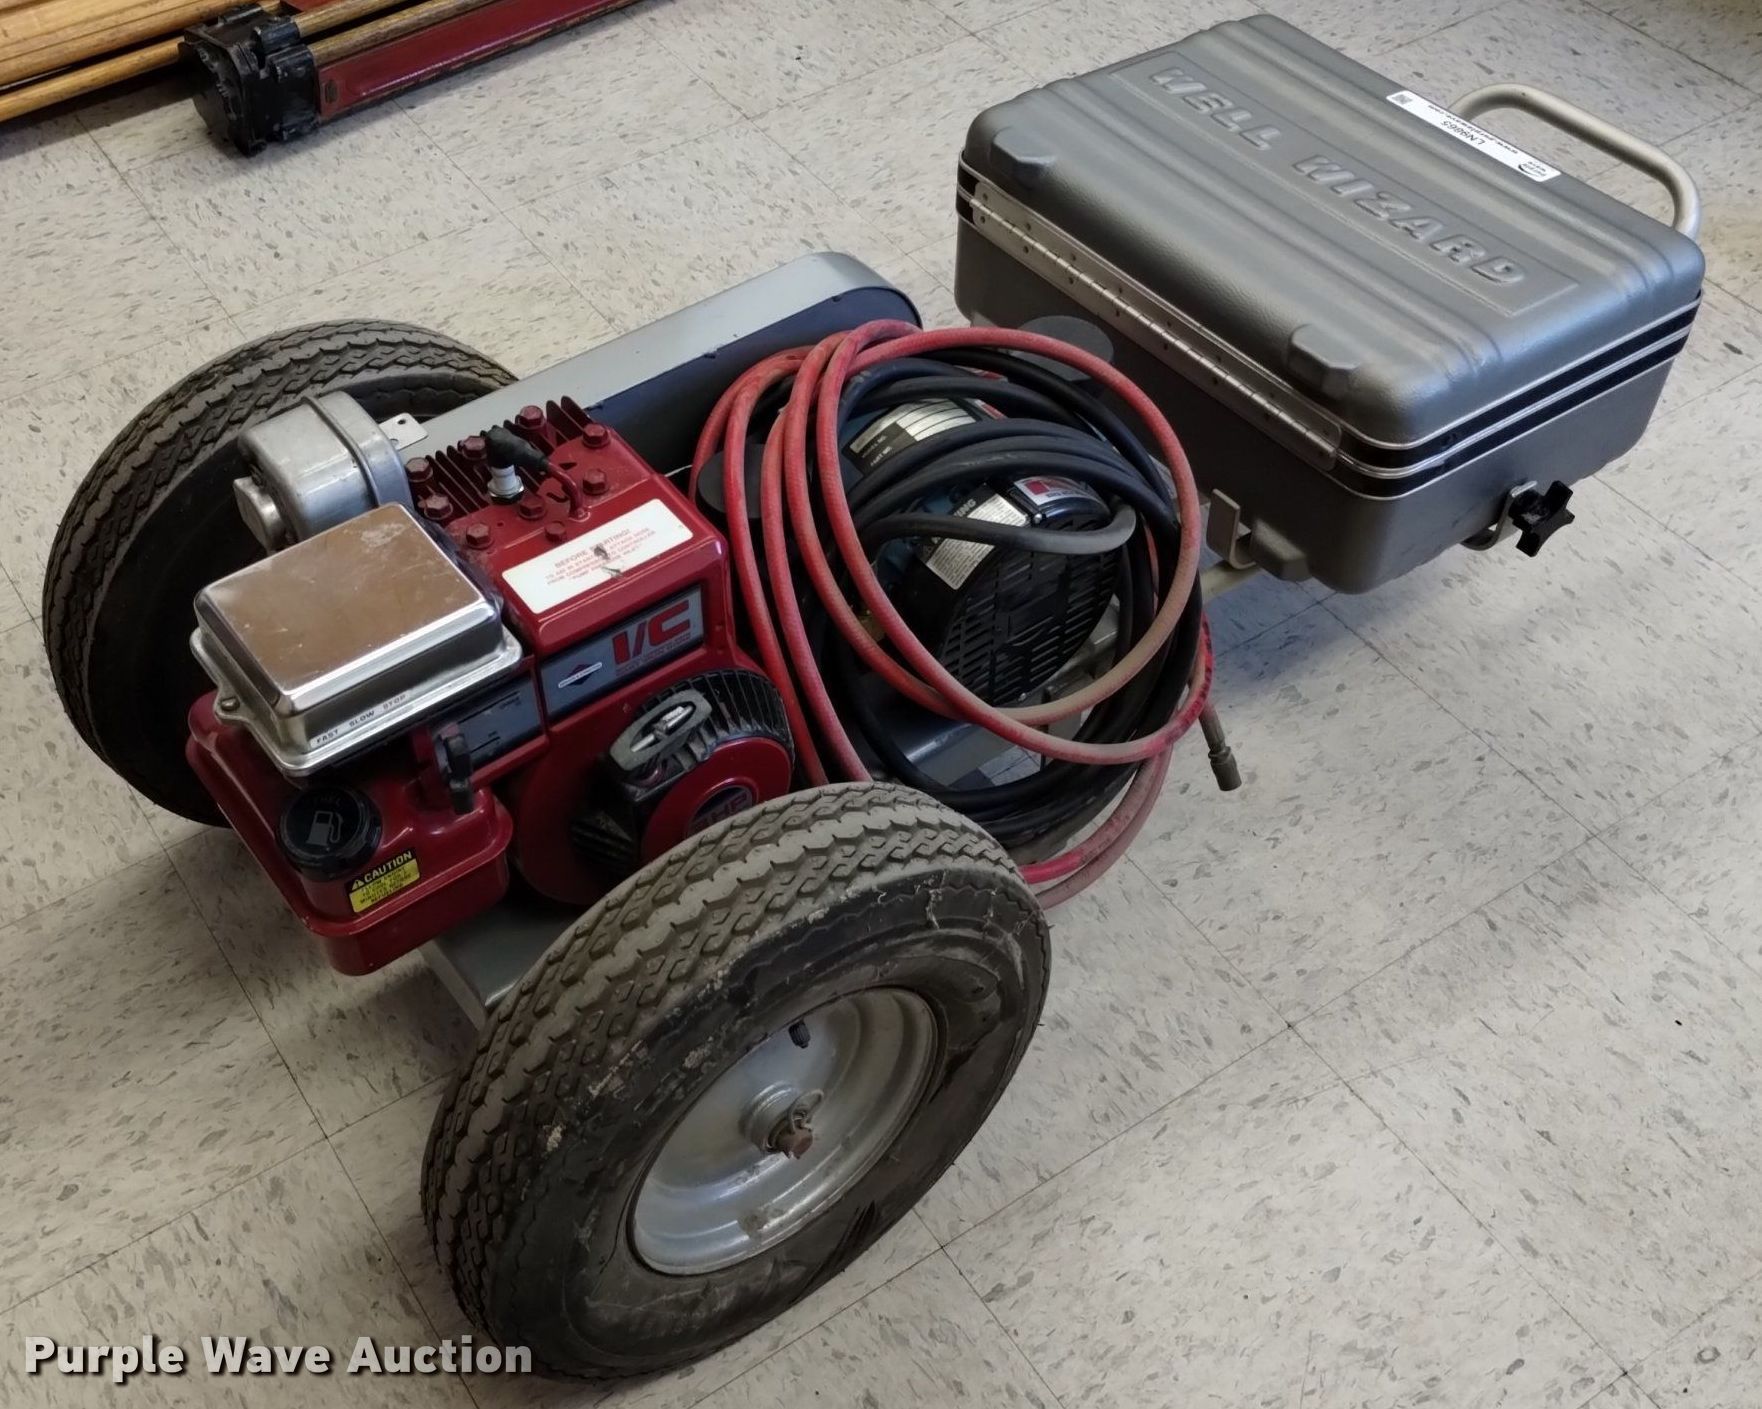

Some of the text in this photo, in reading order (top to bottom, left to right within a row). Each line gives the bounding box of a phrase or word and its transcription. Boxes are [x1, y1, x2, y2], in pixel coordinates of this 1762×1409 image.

[1149, 67, 1527, 284] WELL WIZARD
[612, 599, 690, 665] I/C
[316, 694, 407, 744] FAST SLOW STOP
[364, 850, 413, 883] CAUTION
